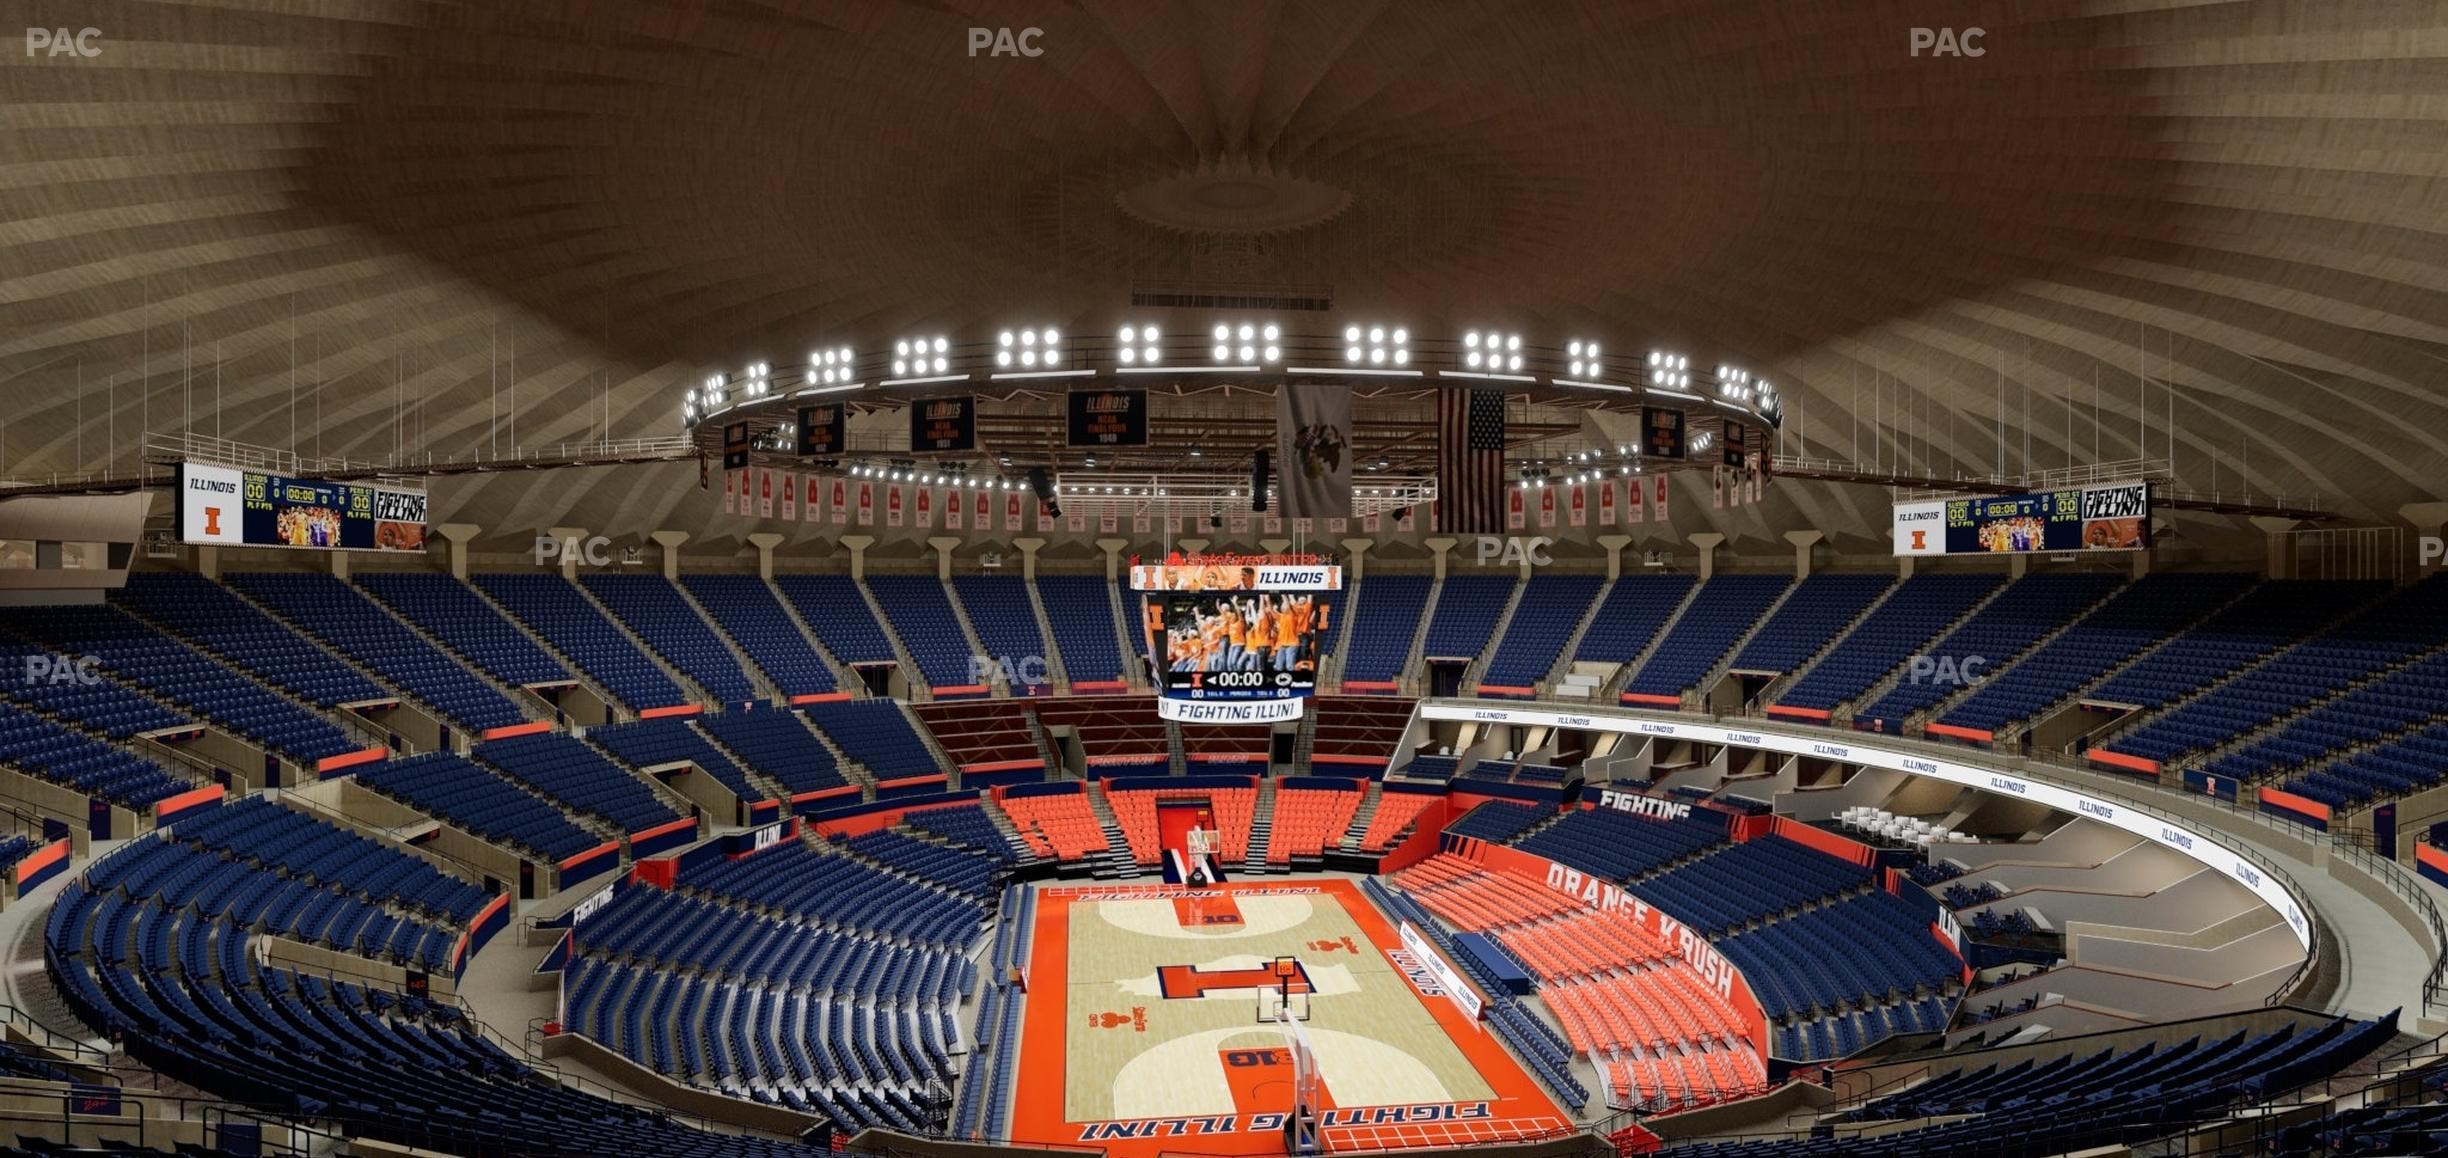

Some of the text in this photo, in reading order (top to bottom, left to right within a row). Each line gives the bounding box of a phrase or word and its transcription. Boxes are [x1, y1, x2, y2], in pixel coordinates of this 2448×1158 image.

[189, 478, 236, 494] ILLINOIS
[246, 484, 263, 499] 00
[288, 488, 315, 501] 00:00
[378, 491, 426, 510] FIGHTING
[2085, 486, 2144, 503] FIGHTING
[353, 496, 369, 509] 00
[1989, 504, 2016, 514] 00:00
[2058, 499, 2076, 512] 00
[2084, 500, 2144, 518] ILLINI
[376, 503, 426, 522] ILLINI
[1898, 511, 1940, 522] ILLINOIS
[1949, 508, 1965, 519] 00
[1259, 572, 1324, 584] ILLINOIS
[1218, 671, 1264, 687] 00:00
[1191, 689, 1204, 698] 00
[1276, 688, 1290, 698] 00
[1178, 703, 1294, 719] FIGHTING ILLINI
[1475, 711, 1508, 720] ILLINOIS
[1557, 717, 1590, 726] ILLINOIS
[1641, 724, 1675, 734] ILLINOIS
[1726, 733, 1761, 744] ILLINOIS
[1813, 744, 1848, 756] ILLINOIS
[1903, 758, 1937, 773] ILLINOIS
[1991, 777, 2026, 794] ILLINOIS
[1600, 790, 1692, 820] FIGHTING
[2078, 800, 2113, 819] ILLINOIS
[2161, 828, 2193, 850] ILLINOIS
[1546, 862, 1735, 999] ORANGE KRUSH
[1077, 1113, 1239, 1143] ILLINI
